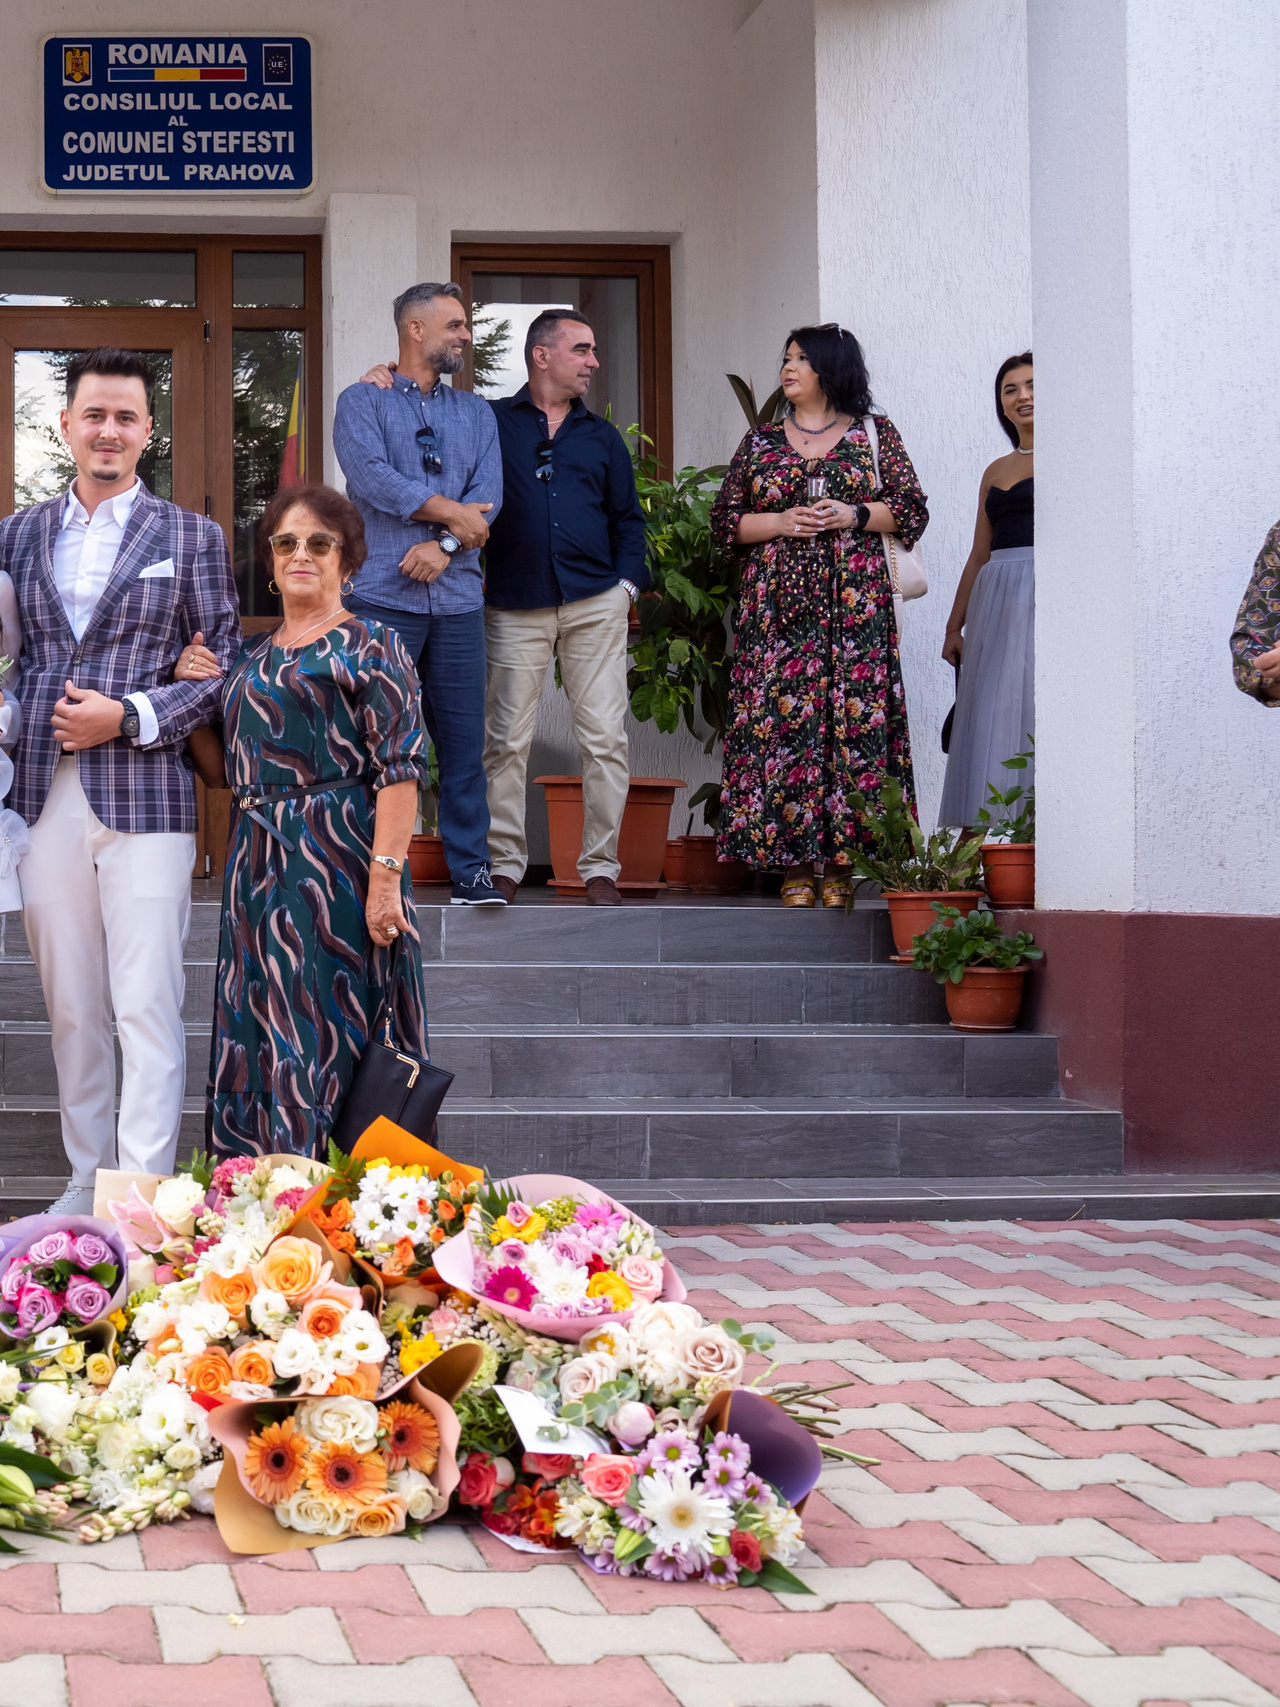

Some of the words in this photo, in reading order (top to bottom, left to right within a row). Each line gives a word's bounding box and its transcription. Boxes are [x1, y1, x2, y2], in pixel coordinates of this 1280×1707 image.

[108, 44, 247, 64] ROMANIA
[64, 93, 201, 110] CONSILIUL
[210, 92, 292, 110] LOCAL
[168, 116, 188, 126] AL
[62, 132, 174, 154] COMUNEI
[182, 131, 295, 153] STEFESTI
[62, 165, 170, 181] JUDETUL
[184, 164, 295, 181] PRAHOVA
